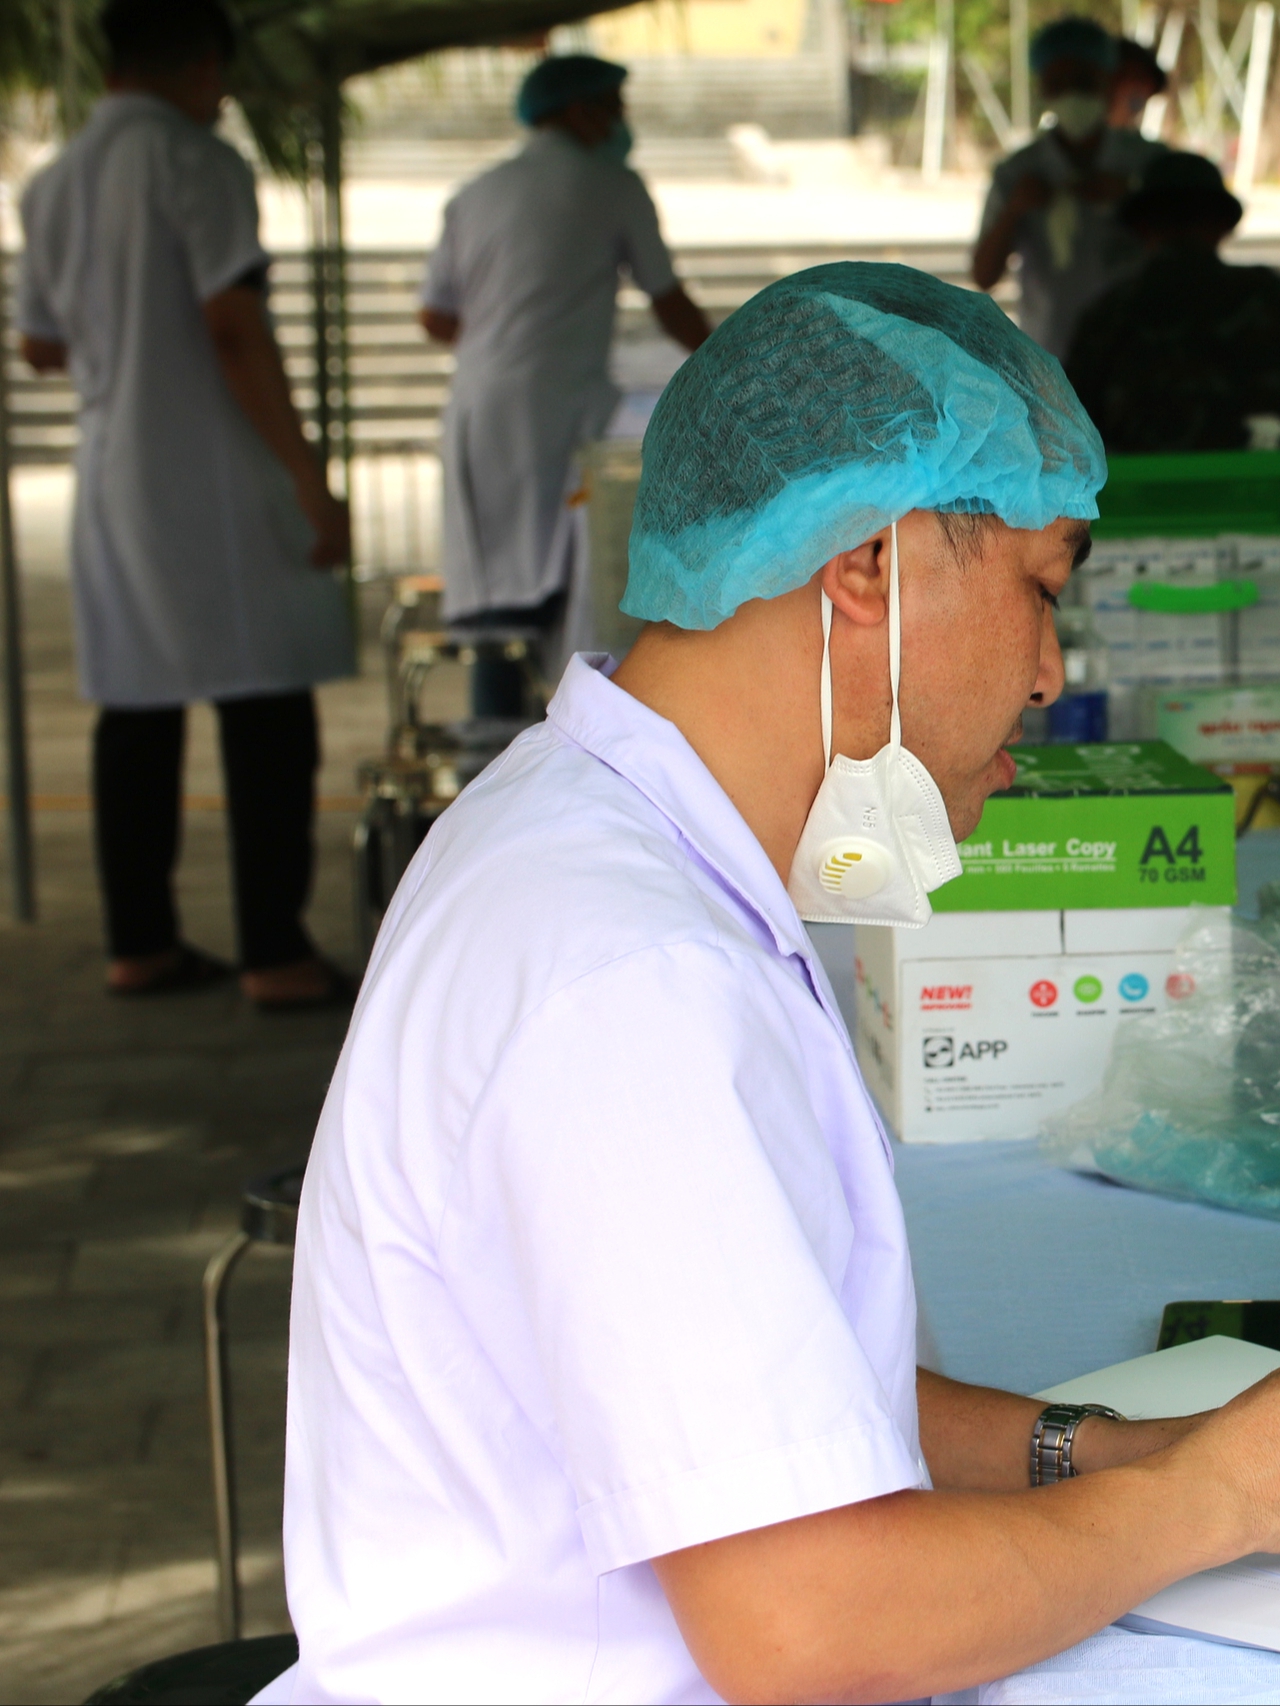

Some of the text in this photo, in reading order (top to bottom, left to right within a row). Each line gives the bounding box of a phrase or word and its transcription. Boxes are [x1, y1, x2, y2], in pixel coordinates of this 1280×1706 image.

[1003, 839, 1056, 857] Laser
[1066, 838, 1116, 860] Copy
[1139, 825, 1203, 865] A4
[1139, 867, 1206, 883] 70 GSM
[921, 985, 973, 1000] NEW!
[958, 1040, 1008, 1061] APP
